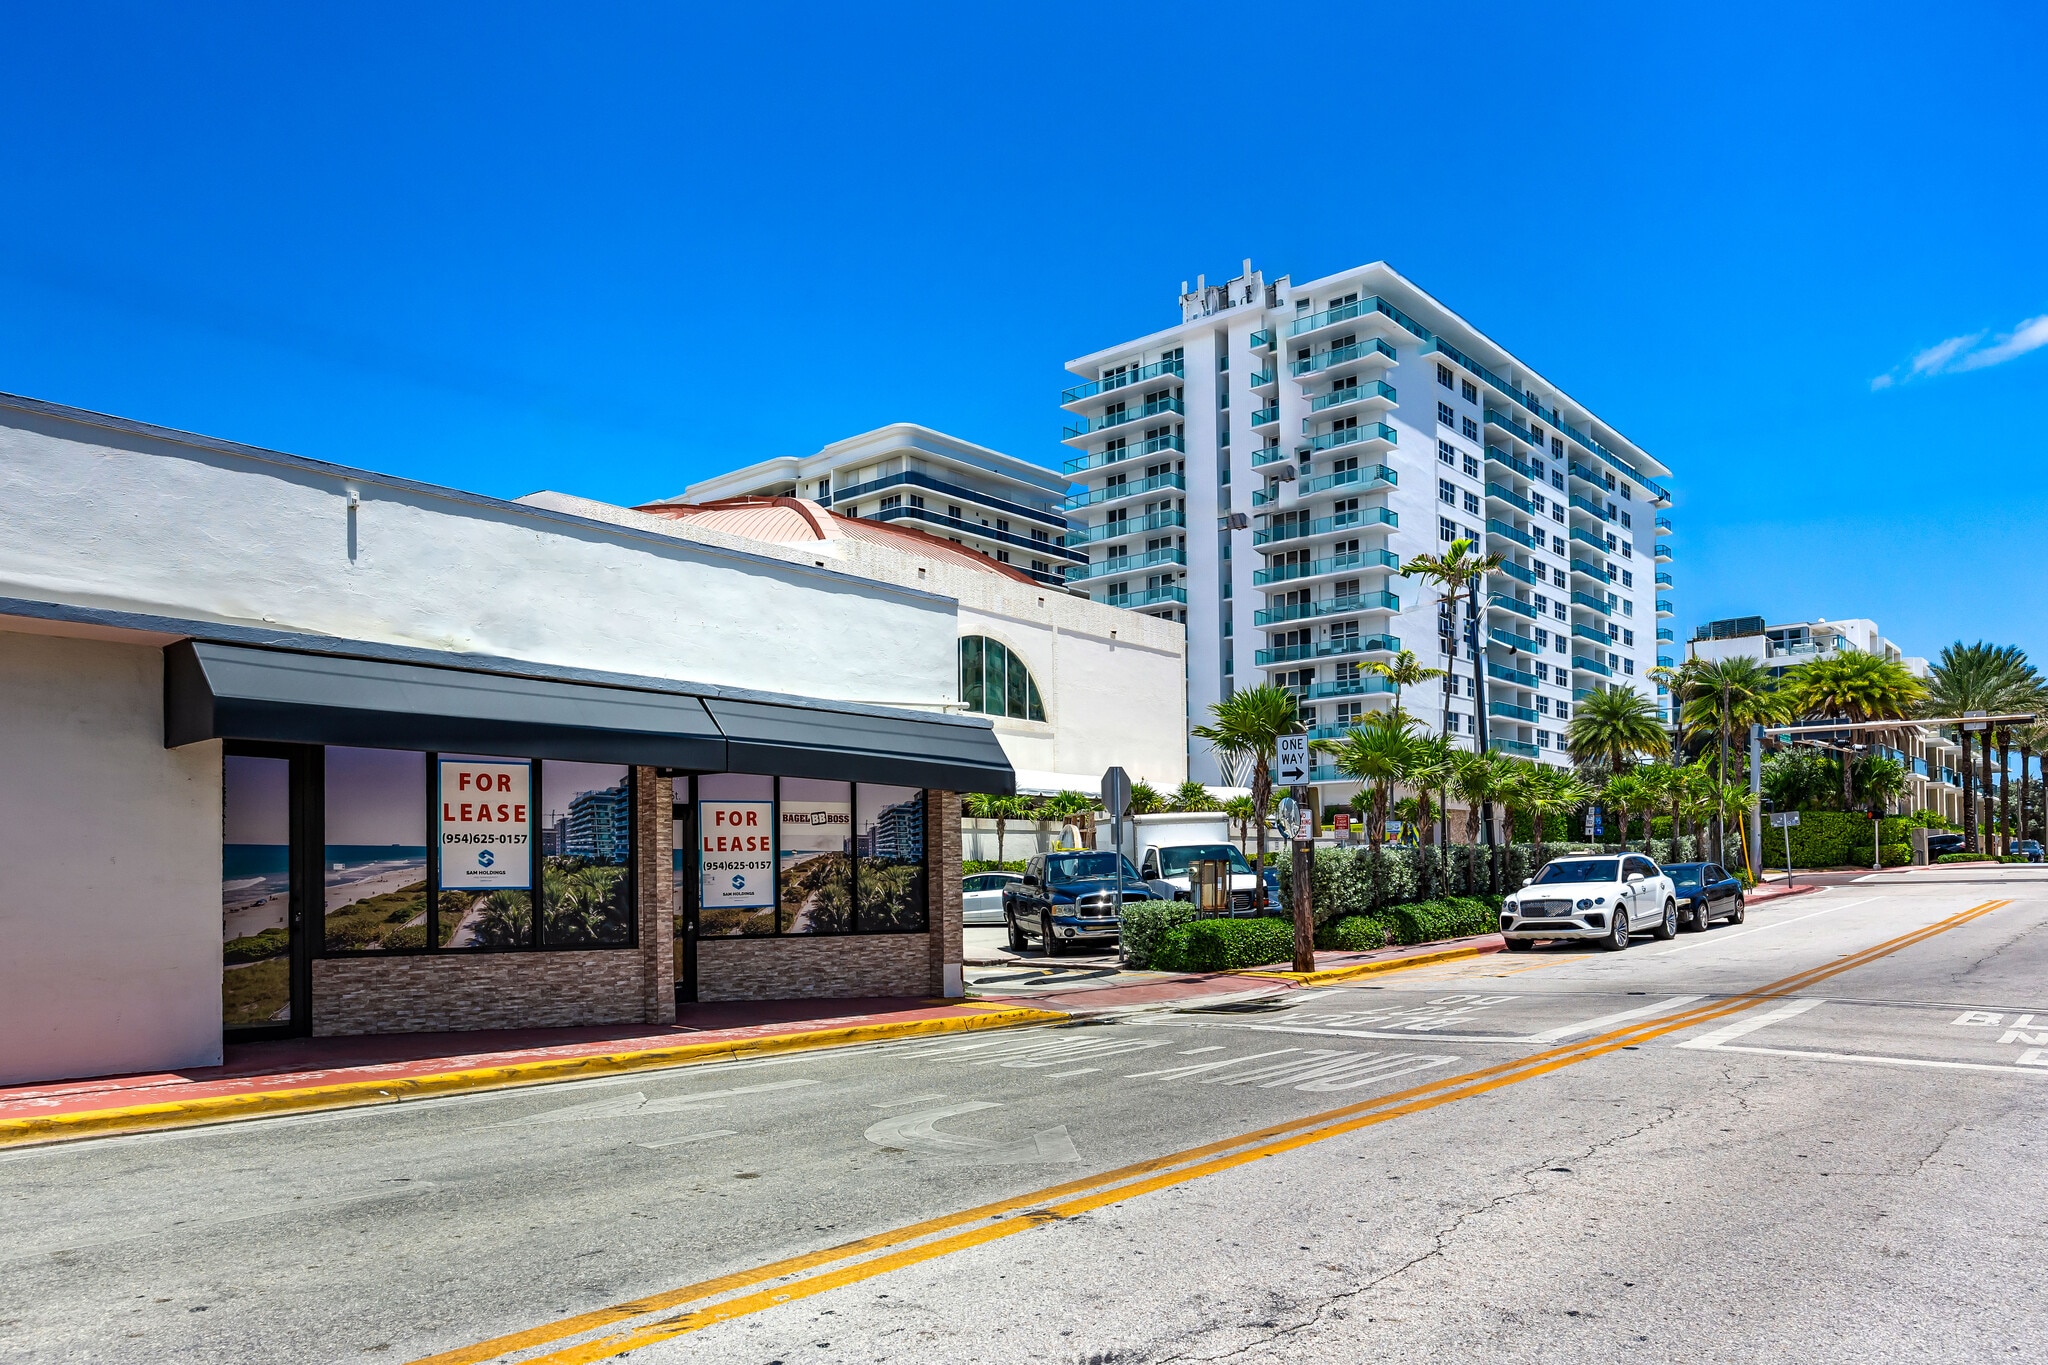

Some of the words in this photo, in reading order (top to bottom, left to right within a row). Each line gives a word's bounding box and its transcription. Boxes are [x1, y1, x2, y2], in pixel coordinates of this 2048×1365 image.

[1281, 739, 1303, 750] ONE
[1281, 753, 1304, 765] WAY
[459, 772, 511, 792] FOR
[443, 803, 526, 822] LEASE
[715, 811, 758, 827] FOR
[782, 814, 810, 822] BAGEL
[811, 812, 826, 825] BB
[827, 814, 849, 823] BOSS
[442, 833, 528, 845] (954)625-0157
[703, 836, 770, 852] LEASE
[703, 861, 772, 871] (954)625-0157
